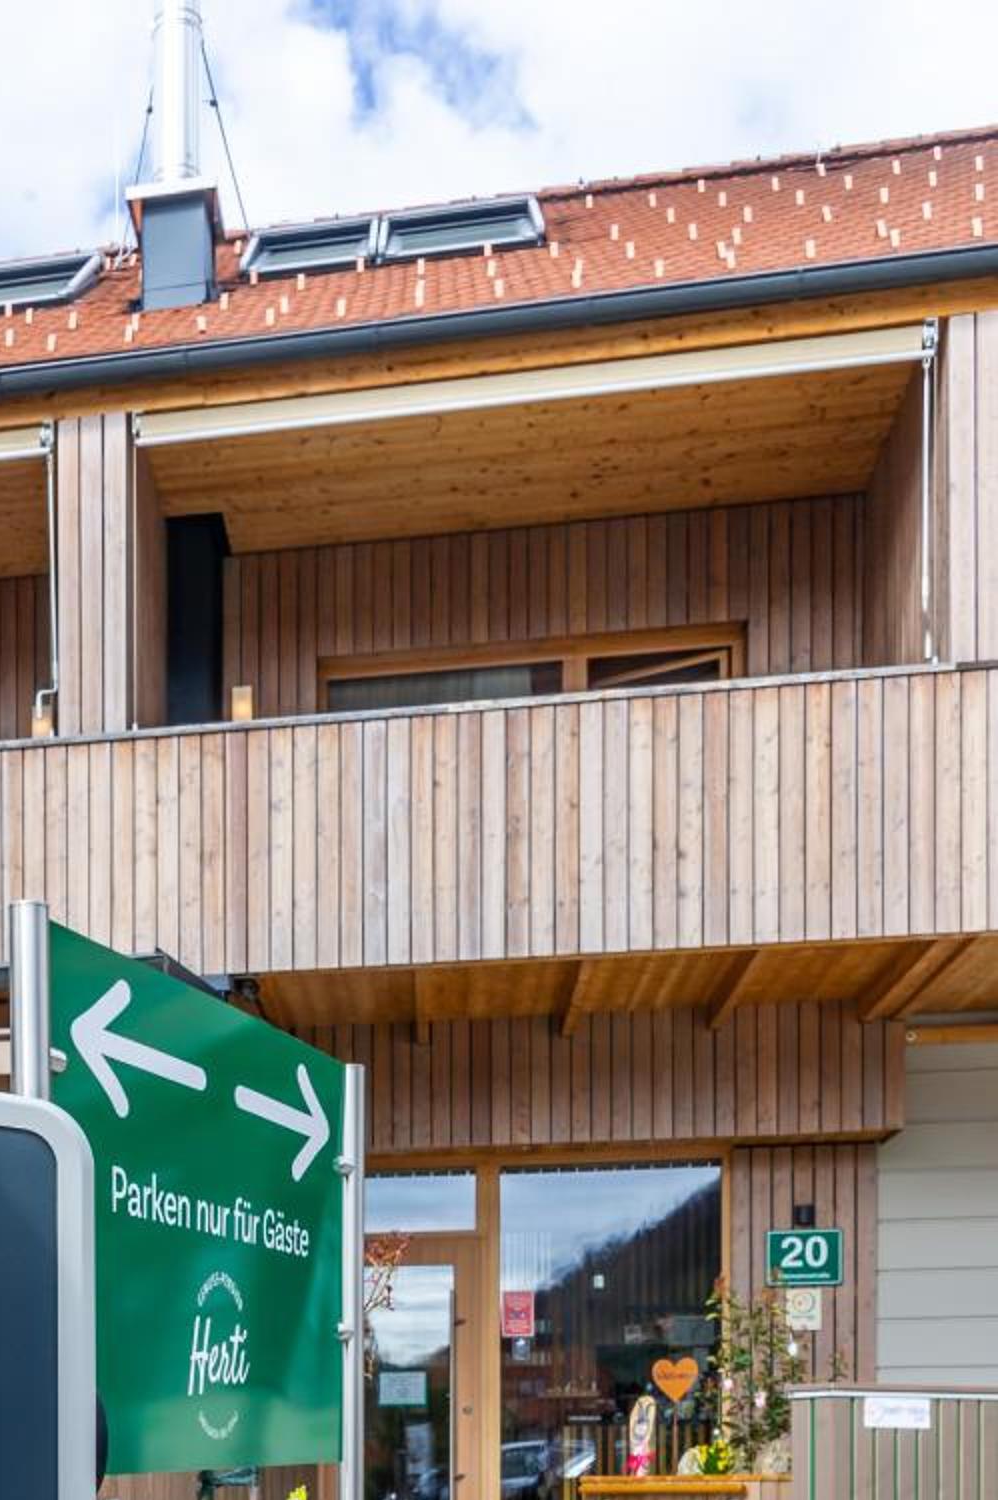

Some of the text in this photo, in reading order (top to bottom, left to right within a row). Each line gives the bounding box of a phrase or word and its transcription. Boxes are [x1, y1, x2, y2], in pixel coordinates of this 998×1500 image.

[111, 1164, 310, 1258] Parken nur für Gäste
[780, 1235, 829, 1268] 20
[187, 1314, 250, 1397] Herti
